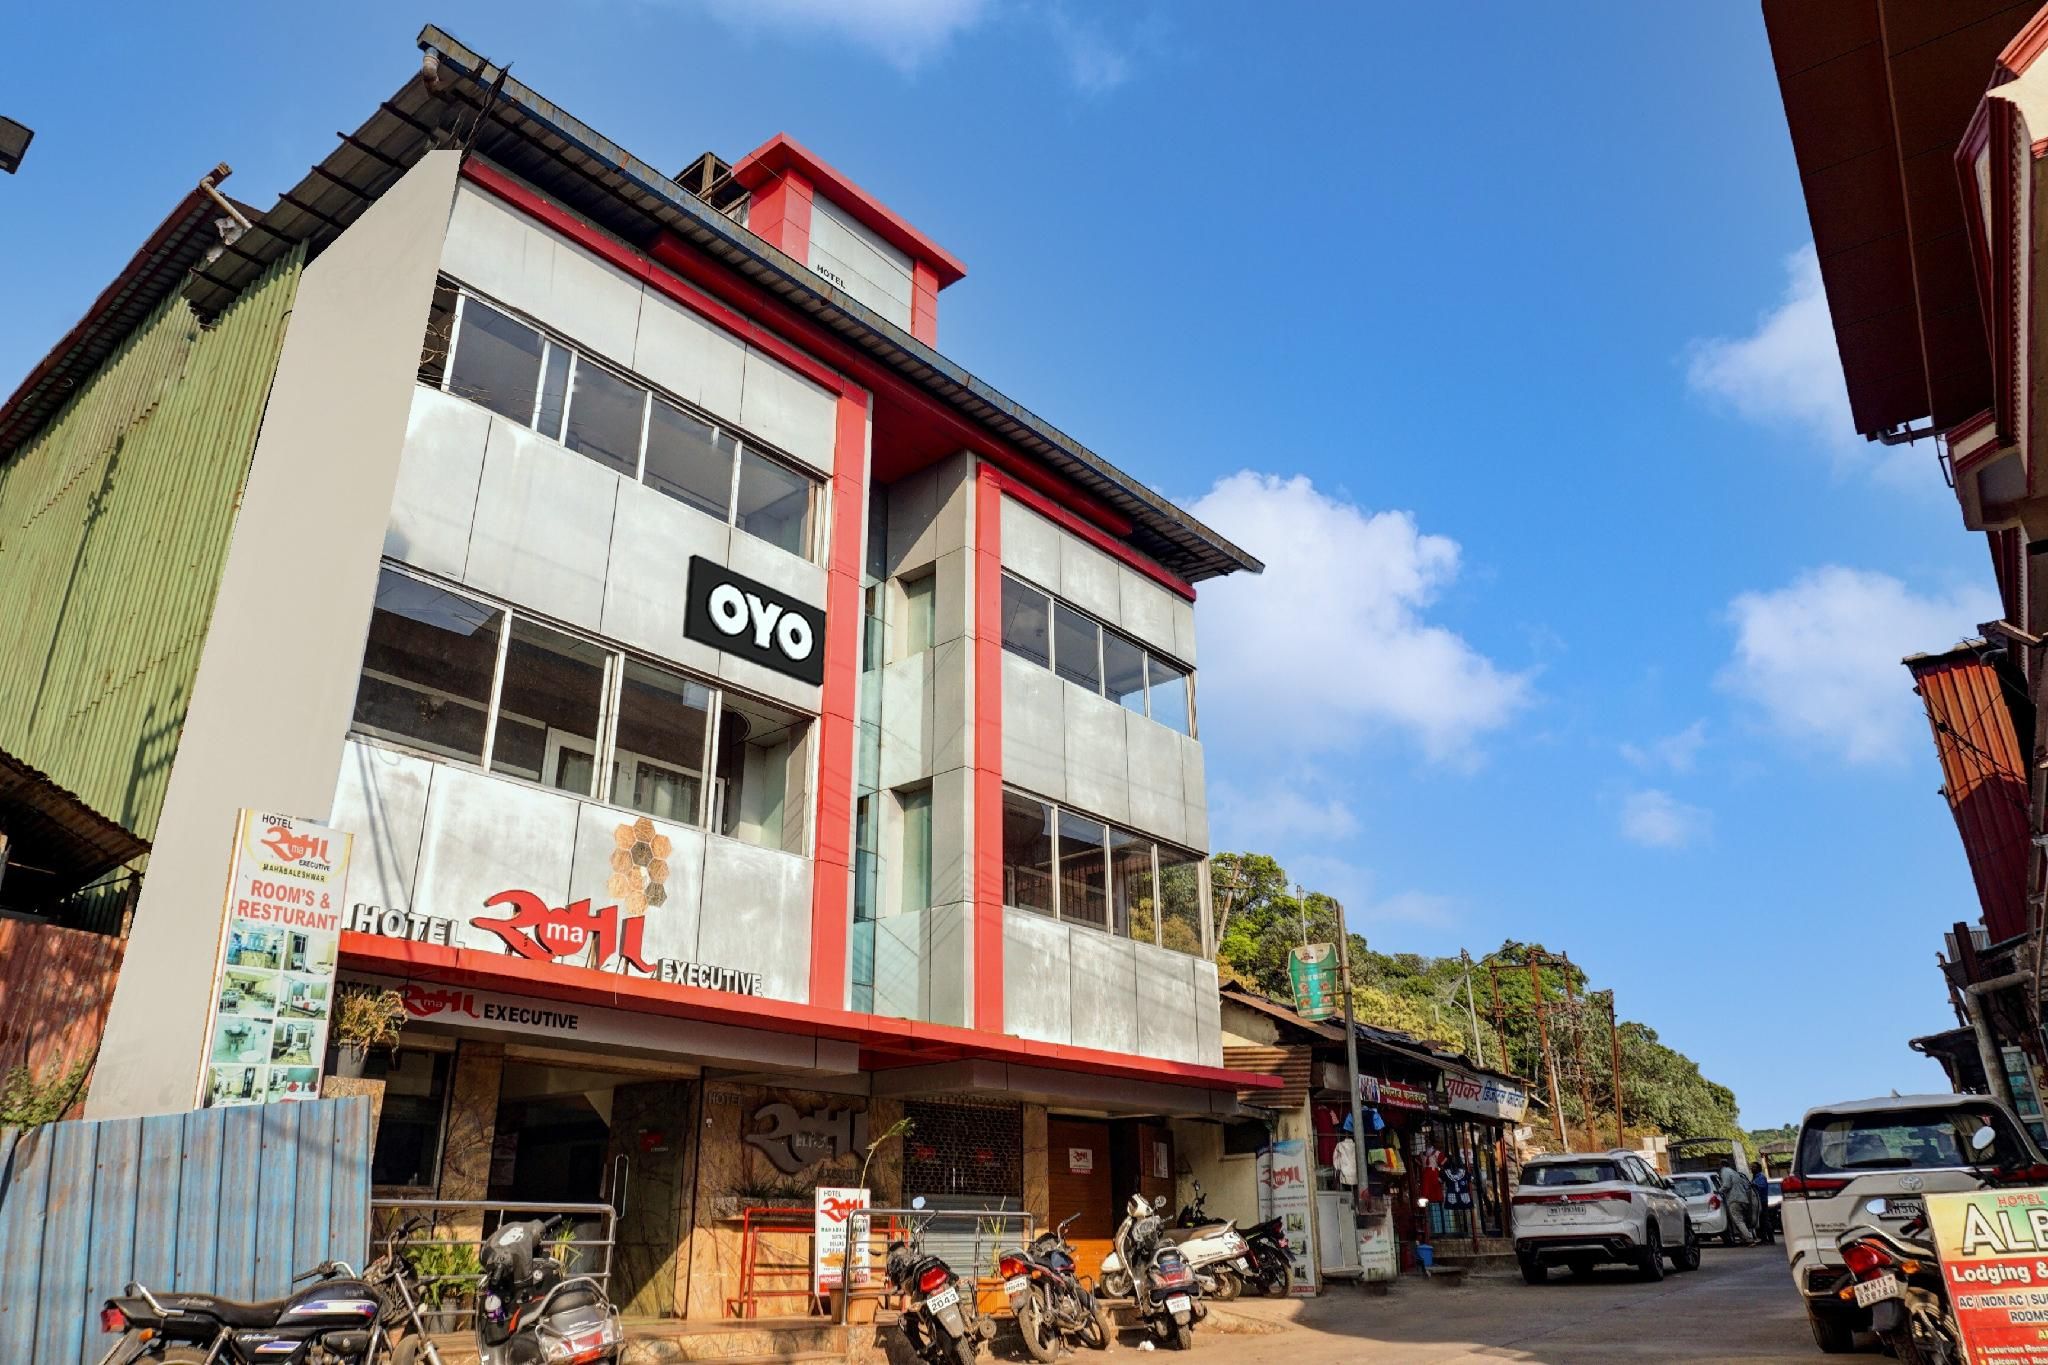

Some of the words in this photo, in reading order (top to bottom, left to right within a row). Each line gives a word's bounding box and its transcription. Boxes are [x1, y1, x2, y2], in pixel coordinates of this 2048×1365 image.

[817, 264, 846, 289] HOTEL
[708, 583, 814, 662] OYO
[261, 813, 294, 830] HOTEL
[262, 863, 326, 882] MAHABALESHWAR
[298, 859, 331, 872] EXECUTIVE
[250, 879, 316, 907] ROOM'S
[319, 892, 331, 910] &
[237, 898, 339, 931] RESTURANT
[352, 903, 466, 949] HOTEL
[545, 920, 584, 944] ma
[658, 957, 763, 998] EXECUTIVE
[484, 1003, 579, 1031] EXECUTIVE
[708, 1092, 744, 1106] HOTEL
[823, 1190, 842, 1198] HOTEL
[1997, 1193, 2046, 1208] HOTEL
[1951, 1263, 2032, 1286] Lodging
[931, 1293, 957, 1311] 2043
[1959, 1295, 1974, 1308] AC
[1982, 1294, 2006, 1307] NON
[2009, 1294, 2024, 1306] AC
